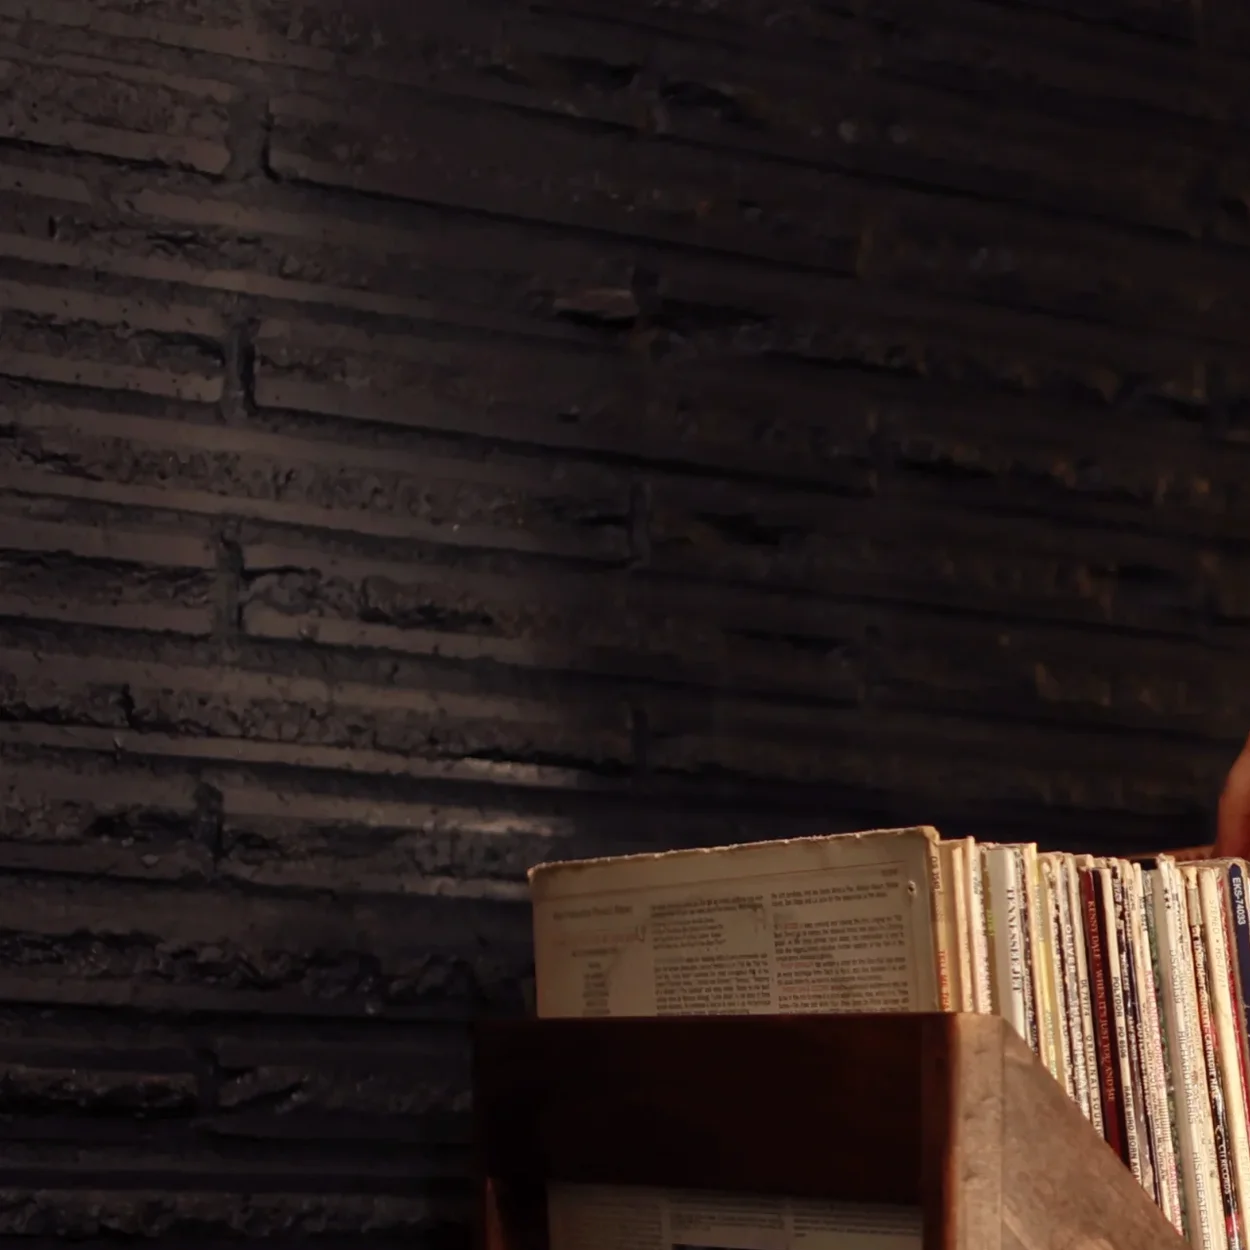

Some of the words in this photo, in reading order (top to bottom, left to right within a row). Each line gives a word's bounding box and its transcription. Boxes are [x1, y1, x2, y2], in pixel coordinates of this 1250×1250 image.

[1087, 900, 1098, 933] KENNY
[1232, 877, 1246, 925] EKS-74033
[1007, 886, 1018, 964] TENNESSEE
[1066, 924, 1075, 973] OLIVER
[1011, 968, 1021, 993] JET
[1095, 969, 1106, 999] WHEN
[1112, 975, 1123, 1018] POLYDOR
[1099, 1019, 1110, 1040] JUST
[1086, 1035, 1097, 1091] ORIGINAL
[1092, 1097, 1103, 1133] SOUN
[1184, 1082, 1195, 1125] HARRIS
[1190, 1151, 1202, 1172] HIS
[1219, 1158, 1231, 1195] RECORDS
[1195, 1173, 1209, 1232] GREATEST
